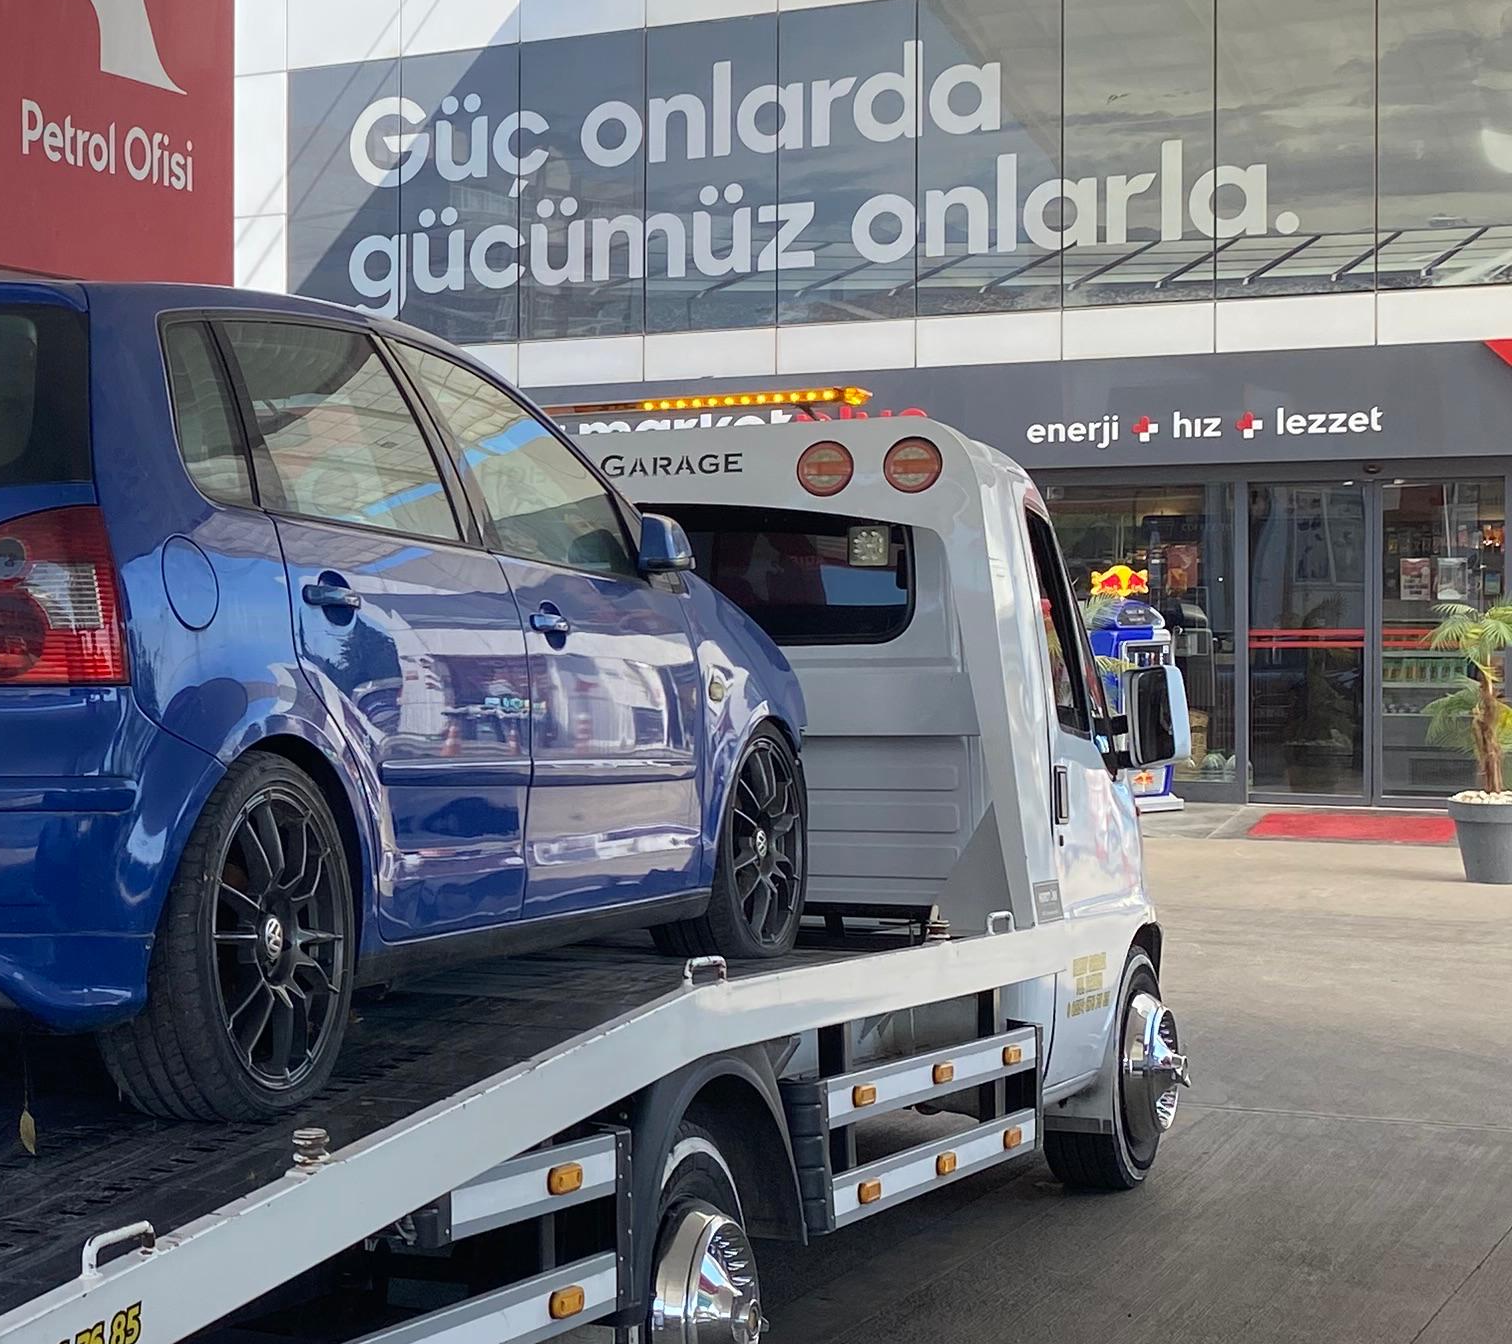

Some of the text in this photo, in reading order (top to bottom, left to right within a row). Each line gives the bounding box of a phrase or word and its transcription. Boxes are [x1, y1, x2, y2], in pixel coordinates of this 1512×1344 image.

[21, 97, 193, 192] Petrol Ofisi
[349, 39, 1001, 198] Güç onlarda
[349, 139, 1301, 320] gücümüz onlarla.
[600, 452, 744, 478] GARAGE
[1025, 406, 1384, 449] enerji hız lezzet
